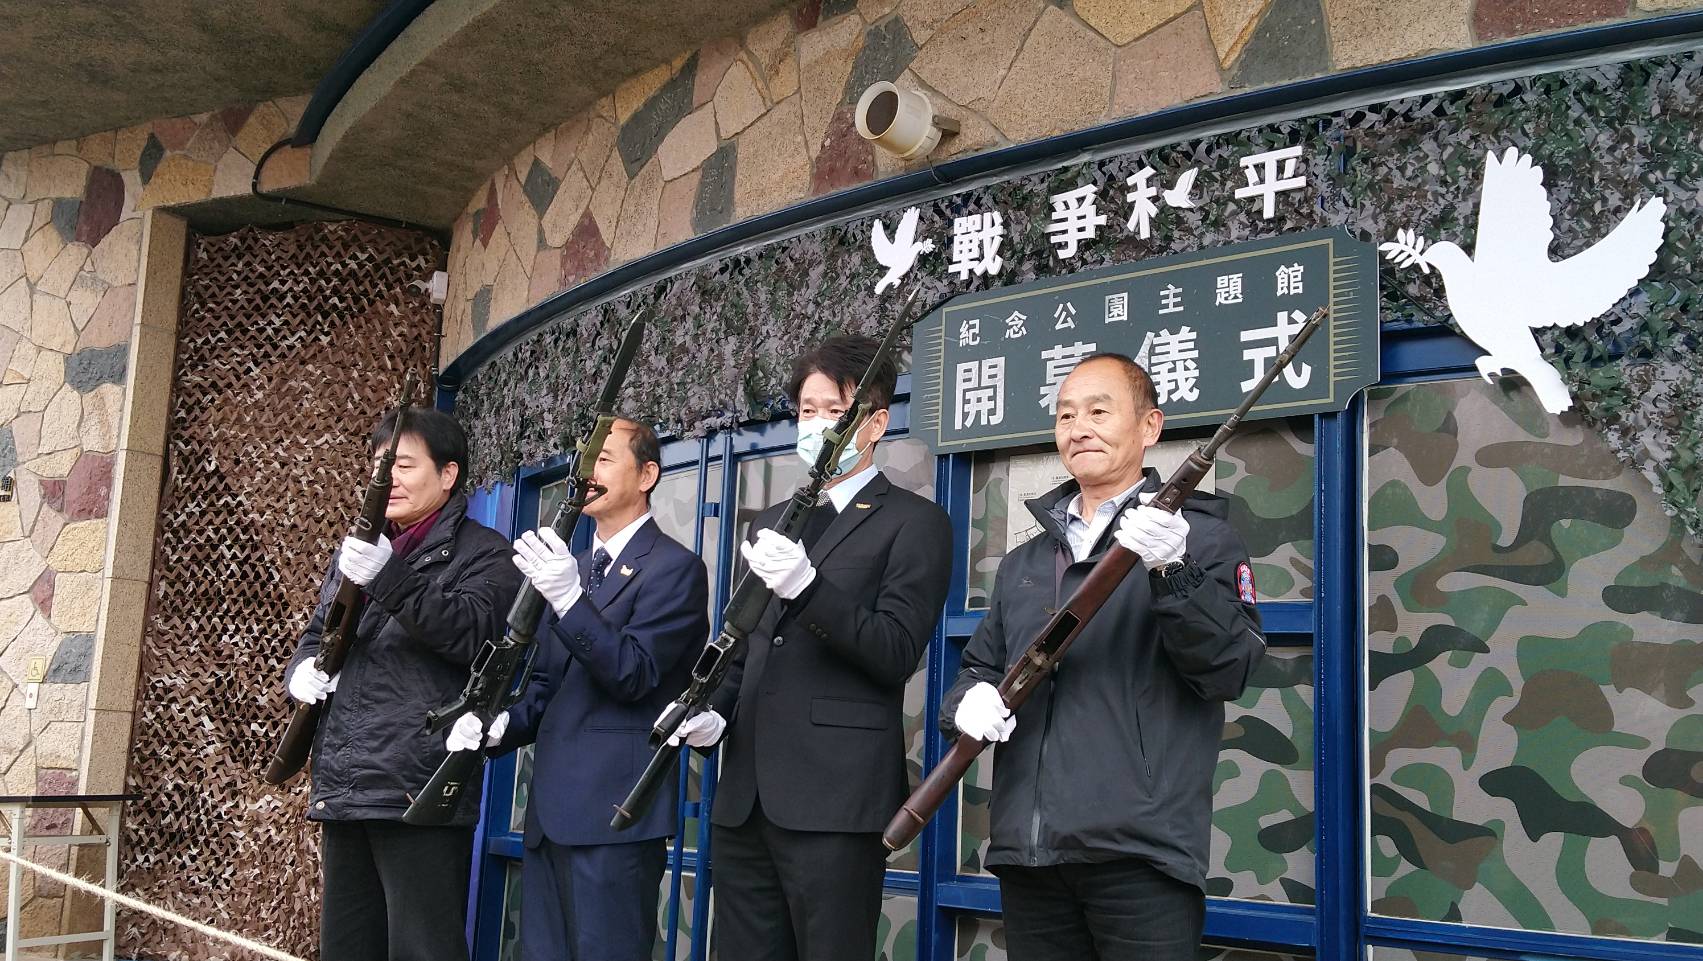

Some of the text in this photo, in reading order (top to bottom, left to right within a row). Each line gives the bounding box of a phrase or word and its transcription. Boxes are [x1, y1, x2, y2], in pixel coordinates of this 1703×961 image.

[948, 145, 1307, 280] 戰爭和平
[958, 263, 1305, 347] 紀念公園主題館
